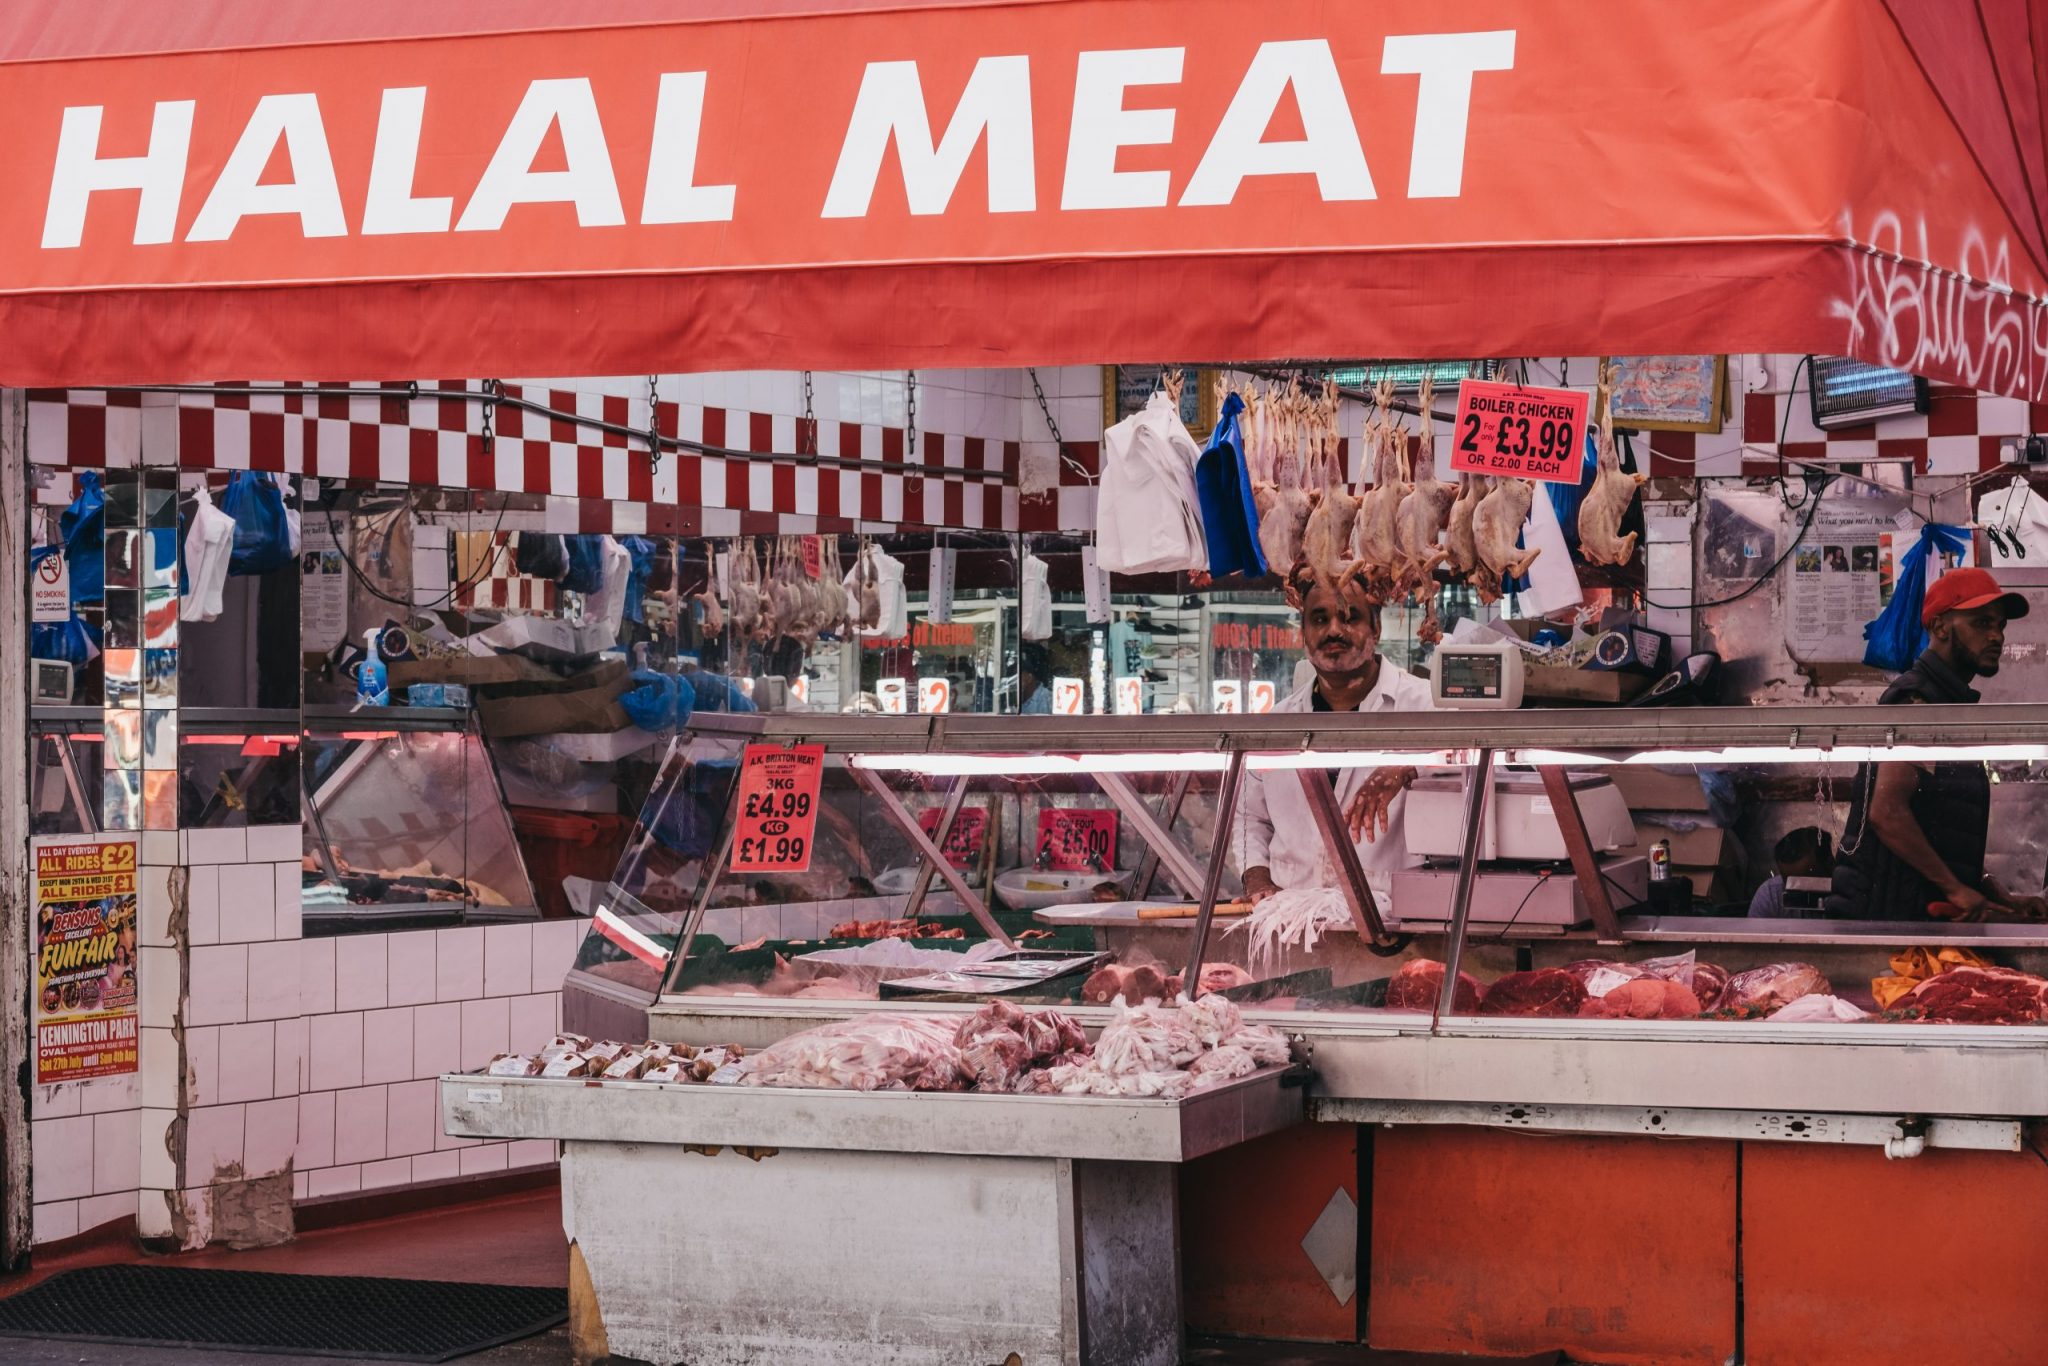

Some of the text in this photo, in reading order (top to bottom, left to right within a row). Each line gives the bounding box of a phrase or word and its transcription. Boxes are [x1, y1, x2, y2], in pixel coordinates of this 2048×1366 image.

[40, 29, 1517, 249] HALAL MEAT
[1469, 397, 1574, 421] BOILER CHICKEN
[1460, 413, 1481, 452] 2
[1484, 423, 1495, 431] For
[1481, 434, 1495, 443] only
[1496, 416, 1573, 461] £3.99
[1467, 453, 1560, 473] OR £2.00 EACH
[1818, 517, 1838, 525] What
[1840, 518, 1854, 528] you
[1855, 516, 1874, 525] need
[1875, 517, 1883, 525] to
[766, 754, 796, 763] BRIXTON
[796, 755, 816, 766] MEAT
[766, 778, 795, 790] 3KG
[745, 793, 811, 818] £4.99
[765, 822, 785, 833] KG
[40, 846, 99, 857] ALL DAY EVERYDAY
[740, 837, 804, 863] £1.99
[1042, 828, 1109, 856] 2 £5.00
[41, 855, 100, 872] ALL RIDES
[101, 844, 134, 871] £2
[40, 879, 58, 887] EXCEPT
[41, 884, 112, 898] ALL RIDES
[114, 874, 135, 893] £1
[53, 906, 102, 932] BENSONS
[65, 928, 93, 940] EXCELLENT
[40, 931, 118, 975] FUNFAIR
[40, 1017, 136, 1048] KENNINGTON PARK
[40, 1059, 53, 1072] Sat
[53, 1057, 68, 1071] 27th
[68, 1055, 82, 1069] July
[83, 1053, 99, 1067] until
[100, 1053, 113, 1065] Sun
[125, 1049, 136, 1062] Aug
[41, 1048, 66, 1057] OVAL
